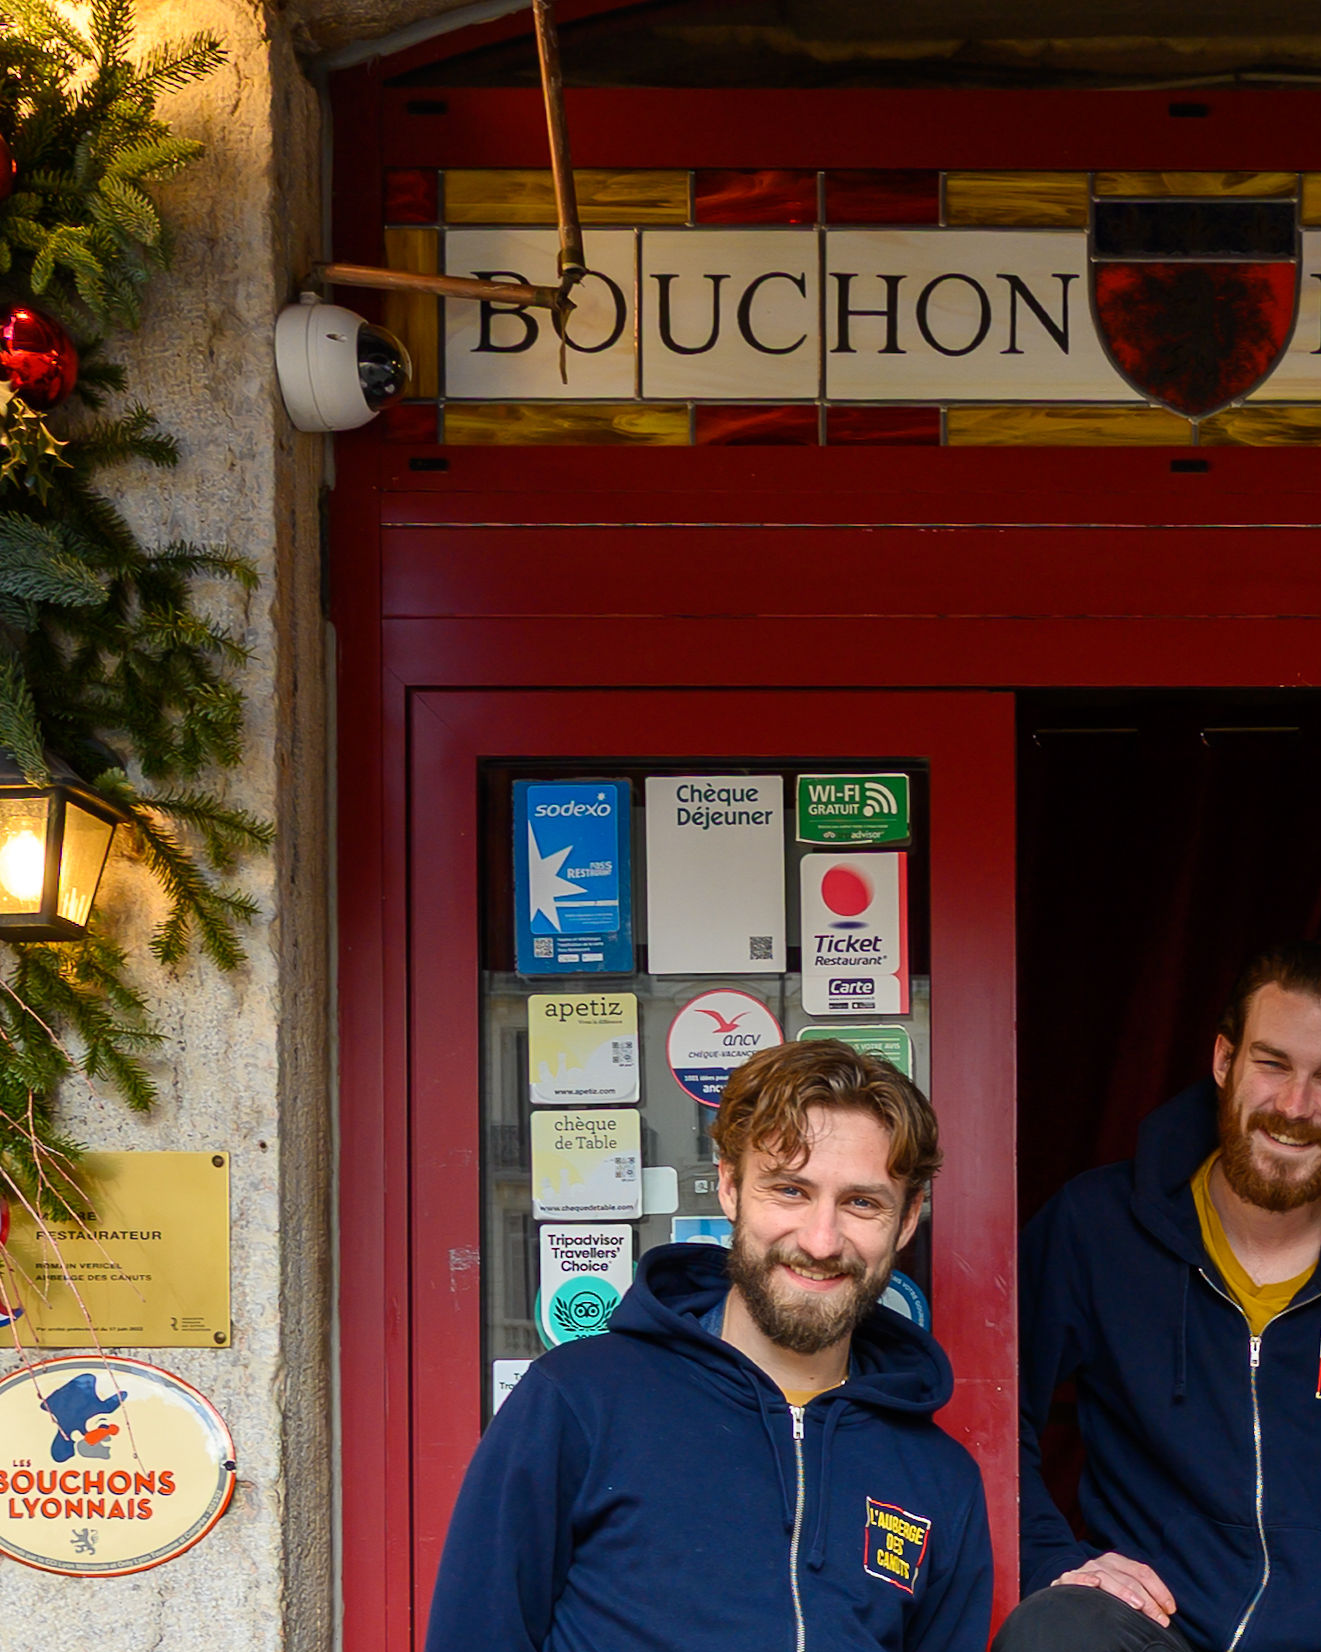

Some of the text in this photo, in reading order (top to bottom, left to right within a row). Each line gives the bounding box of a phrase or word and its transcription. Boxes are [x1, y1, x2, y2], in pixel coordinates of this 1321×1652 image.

[470, 270, 1081, 356] BOUCHON
[676, 783, 759, 806] Chèque
[808, 784, 860, 802] WI-FI
[534, 800, 611, 817] sodexo
[808, 803, 860, 815] GRATUIT
[677, 806, 773, 830] Déjeuner
[814, 935, 882, 953] Ticket
[815, 955, 883, 966] Restaurant
[830, 980, 873, 993] Carte
[545, 997, 623, 1022] apetiz
[722, 1034, 761, 1046] ancv
[554, 1088, 616, 1096] www.apetiz.com
[554, 1115, 617, 1135] chèque
[554, 1135, 617, 1150] de Table
[547, 1234, 624, 1248] Tripadvisor
[561, 1260, 609, 1272] Choice
[13, 1459, 31, 1468] LES
[9, 1497, 153, 1519] LYONNAIS
[869, 1507, 926, 1546] L'AUBERGE
[886, 1532, 905, 1556] DES
[876, 1549, 910, 1580] CANUTS
